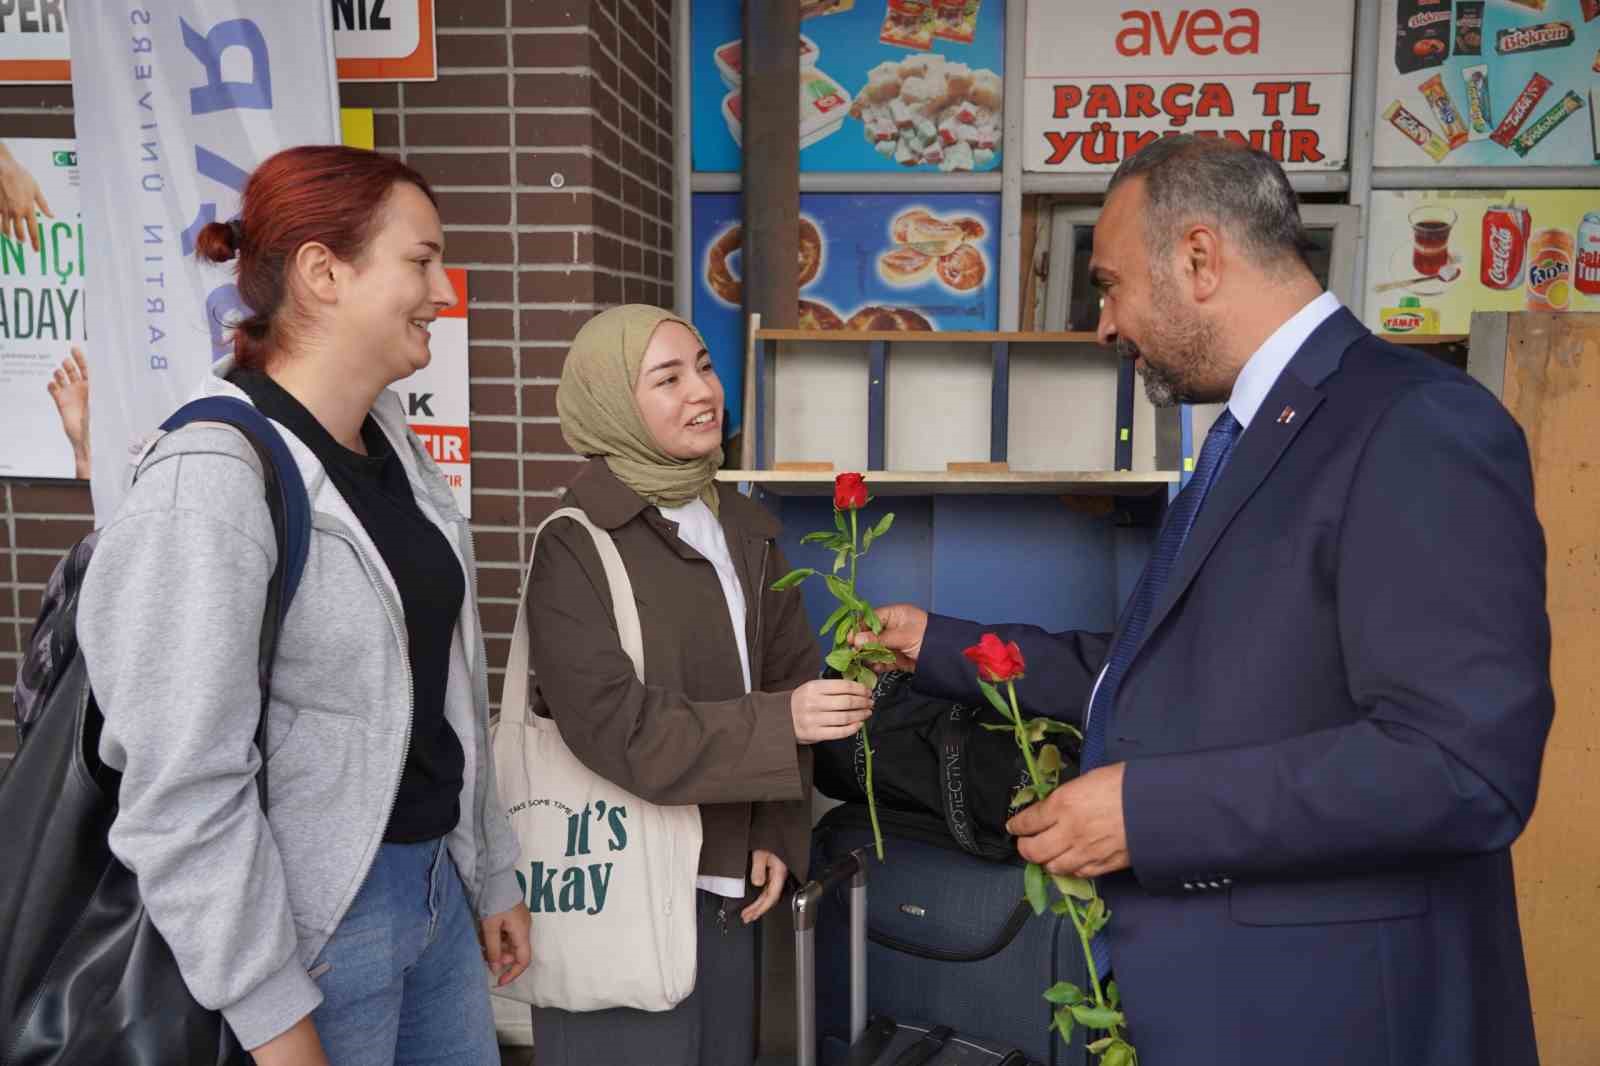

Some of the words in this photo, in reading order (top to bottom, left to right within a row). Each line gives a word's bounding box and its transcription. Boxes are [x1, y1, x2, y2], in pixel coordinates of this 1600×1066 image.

[1115, 8, 1260, 56] avea
[1053, 83, 1234, 126] PARÇA
[1253, 81, 1320, 116] TL
[1043, 120, 1326, 164] YÜKNİR
[441, 473, 462, 487] IR
[528, 799, 550, 808] SOME
[553, 801, 574, 816] TIME
